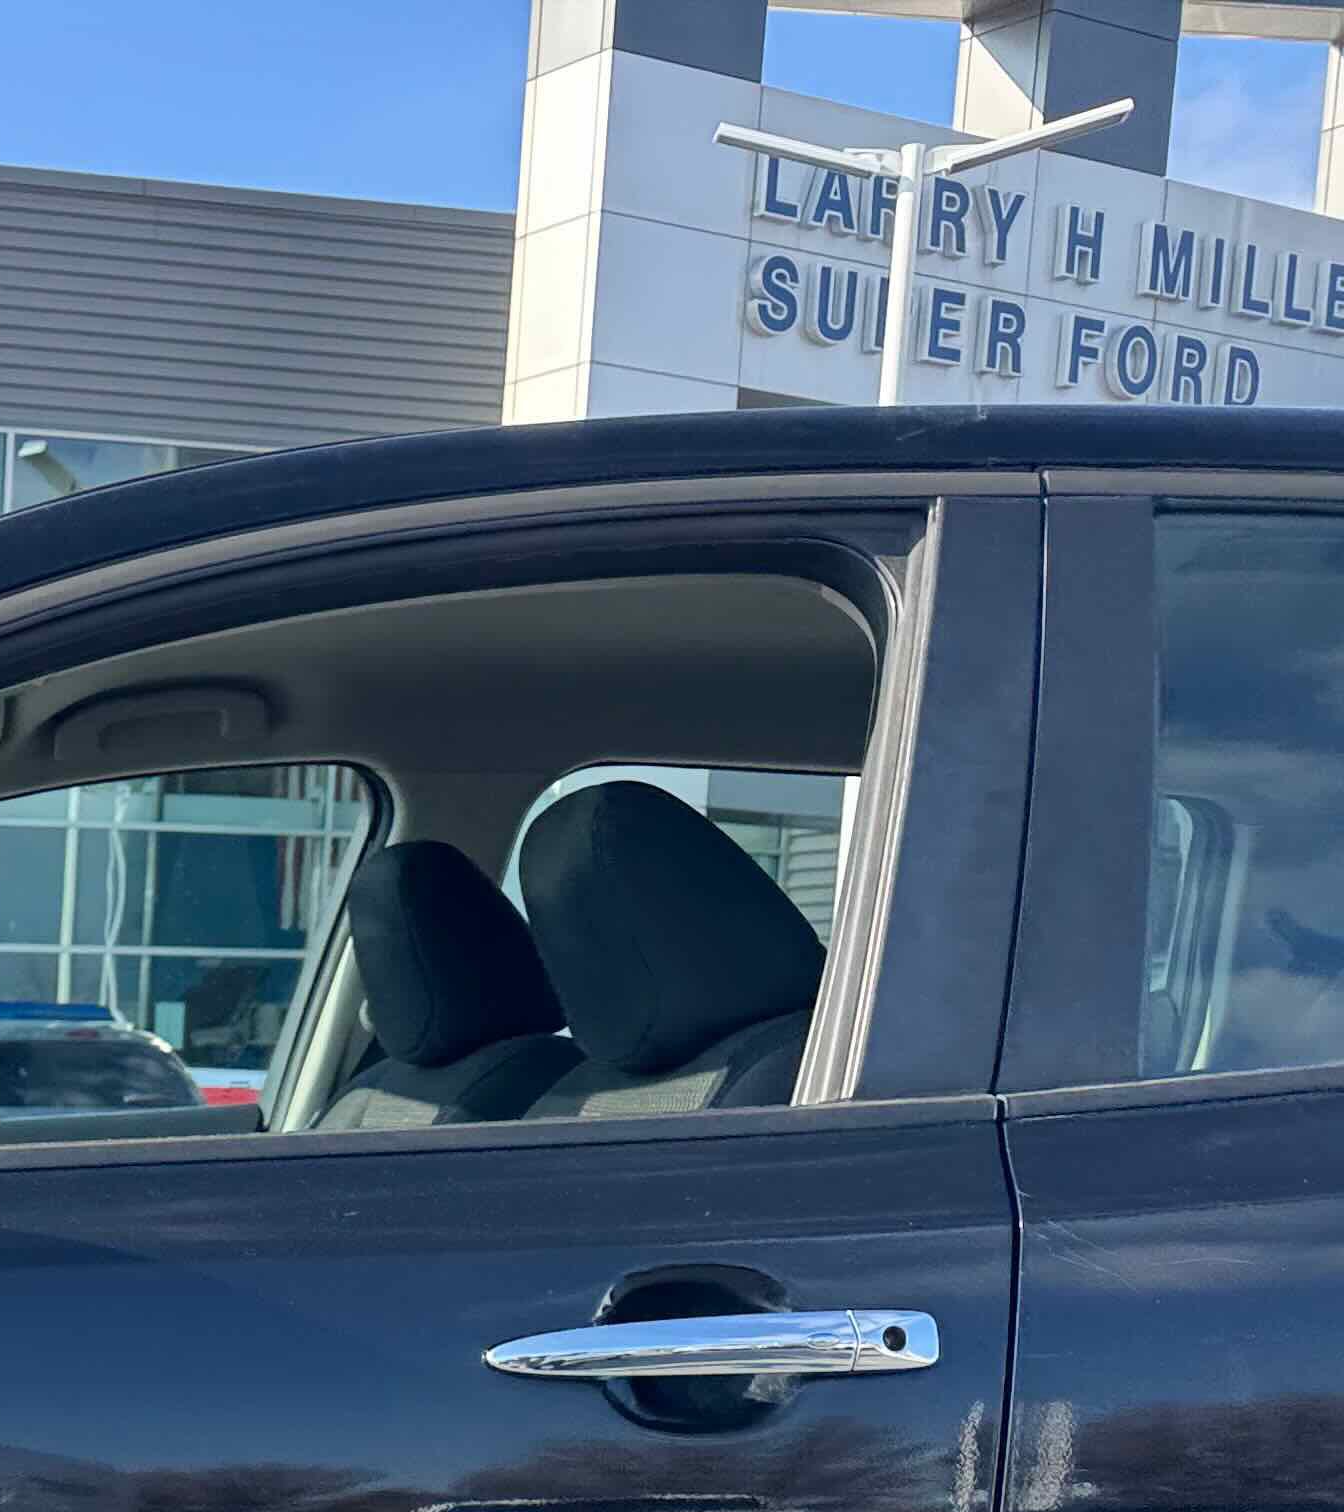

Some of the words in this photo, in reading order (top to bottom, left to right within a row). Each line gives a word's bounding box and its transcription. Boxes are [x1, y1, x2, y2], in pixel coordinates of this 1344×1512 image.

[1061, 203, 1106, 283] H
[756, 254, 1027, 375] SUER
[1066, 313, 1262, 406] FORD
